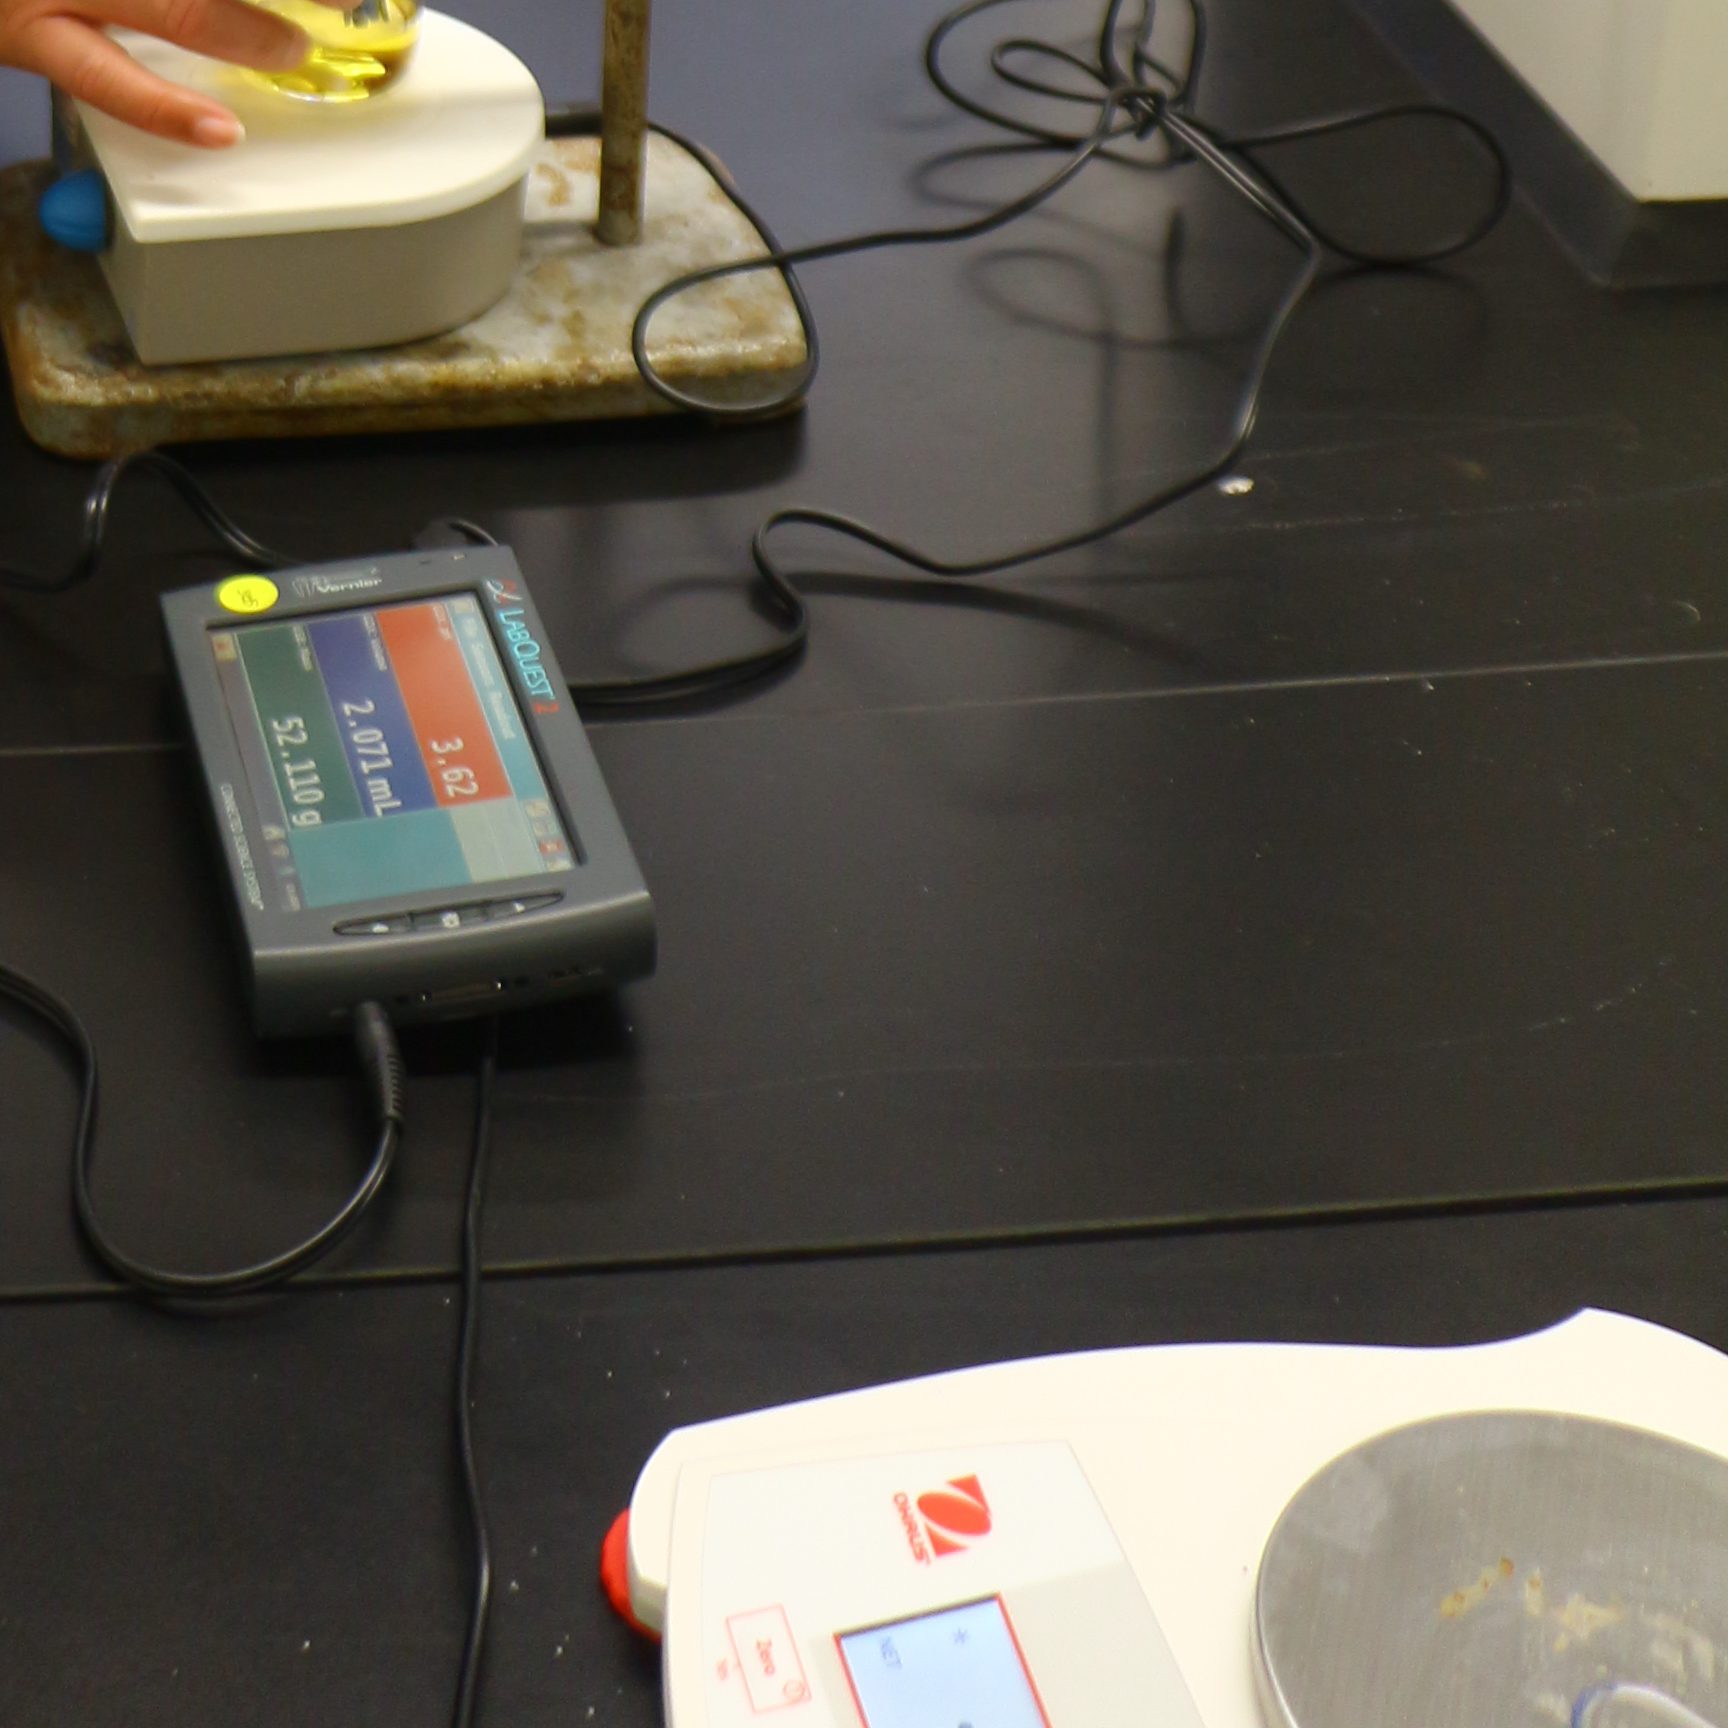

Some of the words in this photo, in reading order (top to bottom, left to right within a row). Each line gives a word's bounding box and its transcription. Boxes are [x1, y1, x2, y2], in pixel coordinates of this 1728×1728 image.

[316, 576, 383, 594] Vernier
[341, 699, 394, 775] 2.071
[272, 716, 325, 805] 52.110
[430, 737, 480, 799] 3.62
[291, 808, 323, 828] g
[367, 777, 403, 819] mL
[756, 1638, 775, 1677] Zero
